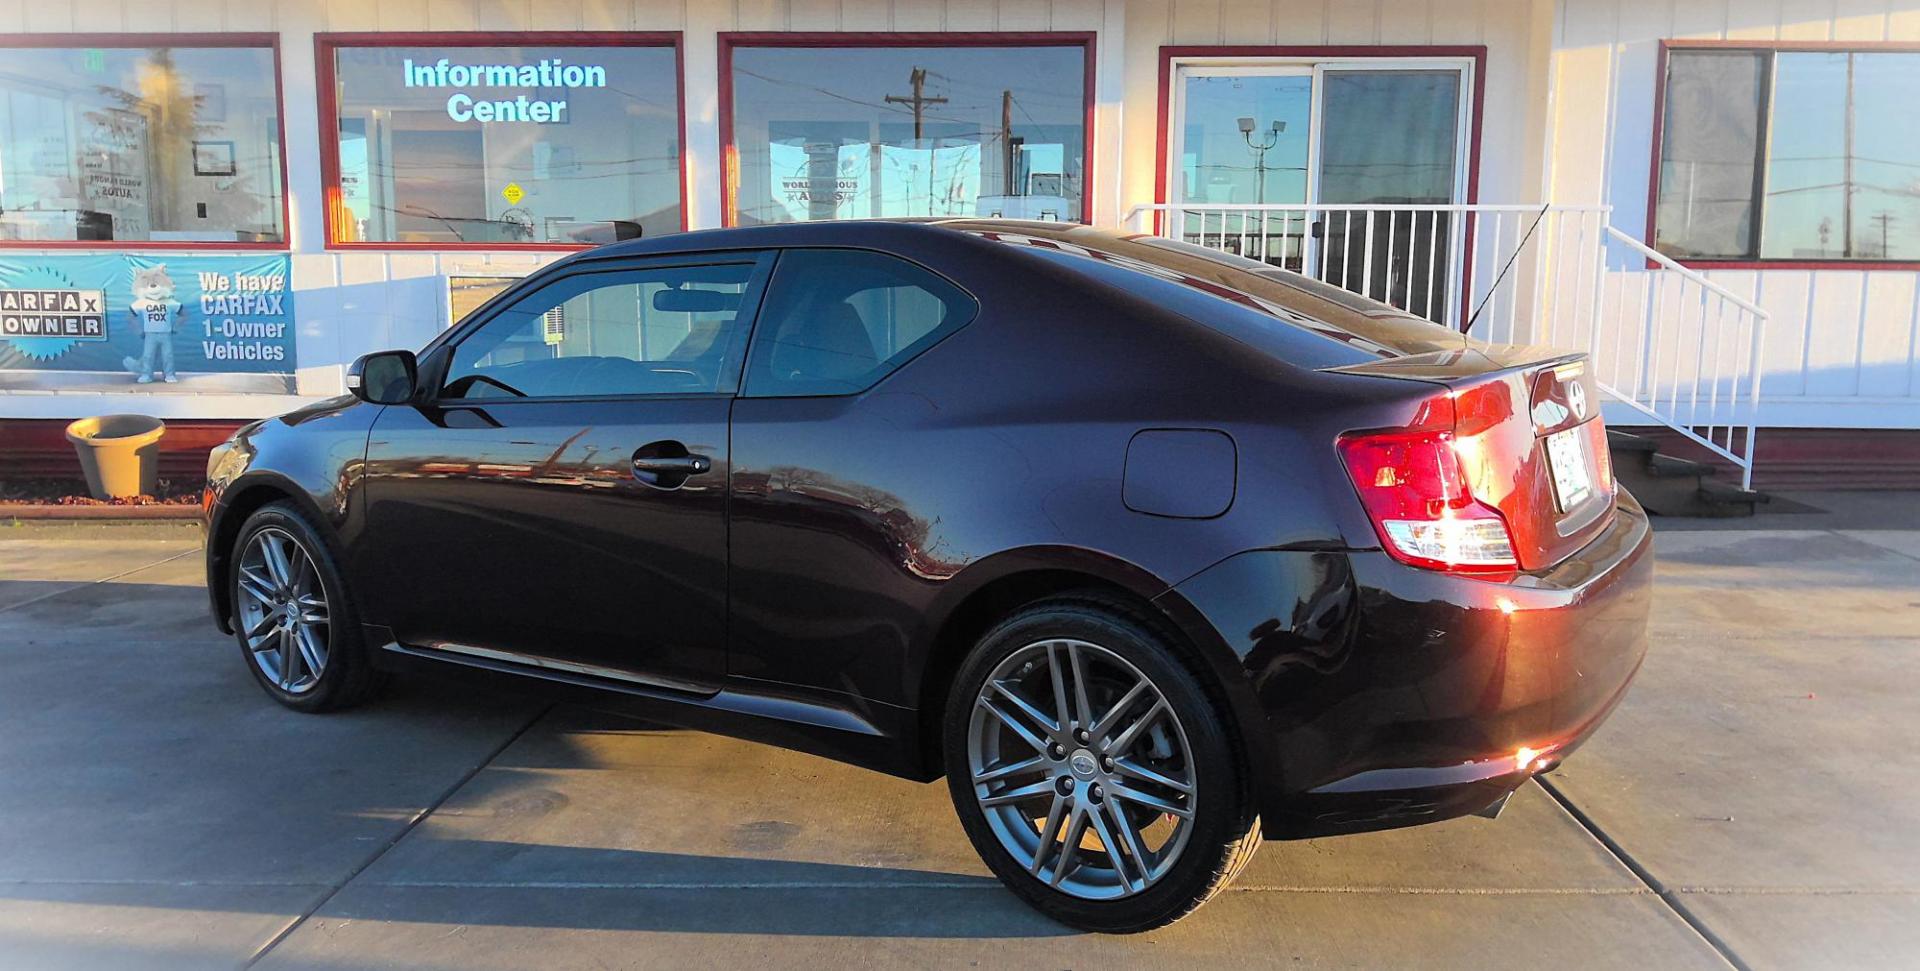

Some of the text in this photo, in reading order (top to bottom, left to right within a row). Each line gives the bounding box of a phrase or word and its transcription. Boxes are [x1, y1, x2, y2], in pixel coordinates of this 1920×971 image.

[403, 58, 606, 88] Information
[447, 93, 567, 123] Center
[782, 181, 817, 190] WORL
[199, 271, 284, 292] We have
[2, 293, 96, 312] ARFAX
[146, 303, 167, 313] CAR
[201, 294, 285, 315] CARFAX
[5, 317, 99, 333] OWNER
[148, 313, 166, 323] FOX
[202, 318, 286, 338] 1-Owner
[202, 341, 284, 361] Vehicles
